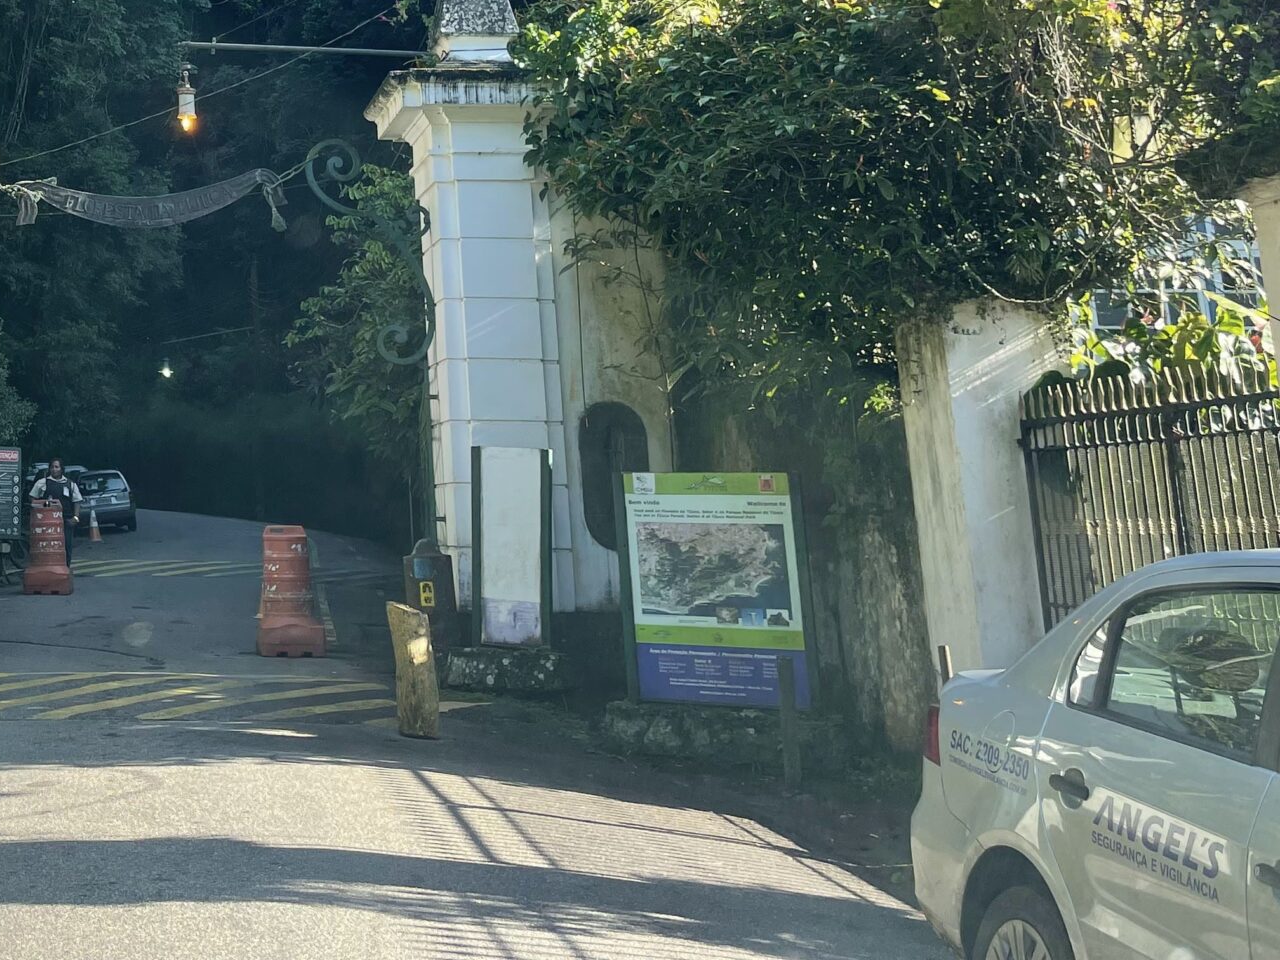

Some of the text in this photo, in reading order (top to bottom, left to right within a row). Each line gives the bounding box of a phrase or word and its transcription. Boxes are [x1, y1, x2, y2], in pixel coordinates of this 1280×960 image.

[950, 730, 1030, 781] SAC: 2209-2350
[1091, 830, 1148, 869] SEGURANÇA
[1151, 858, 1158, 872] E
[1092, 795, 1225, 879] ANGEL'S
